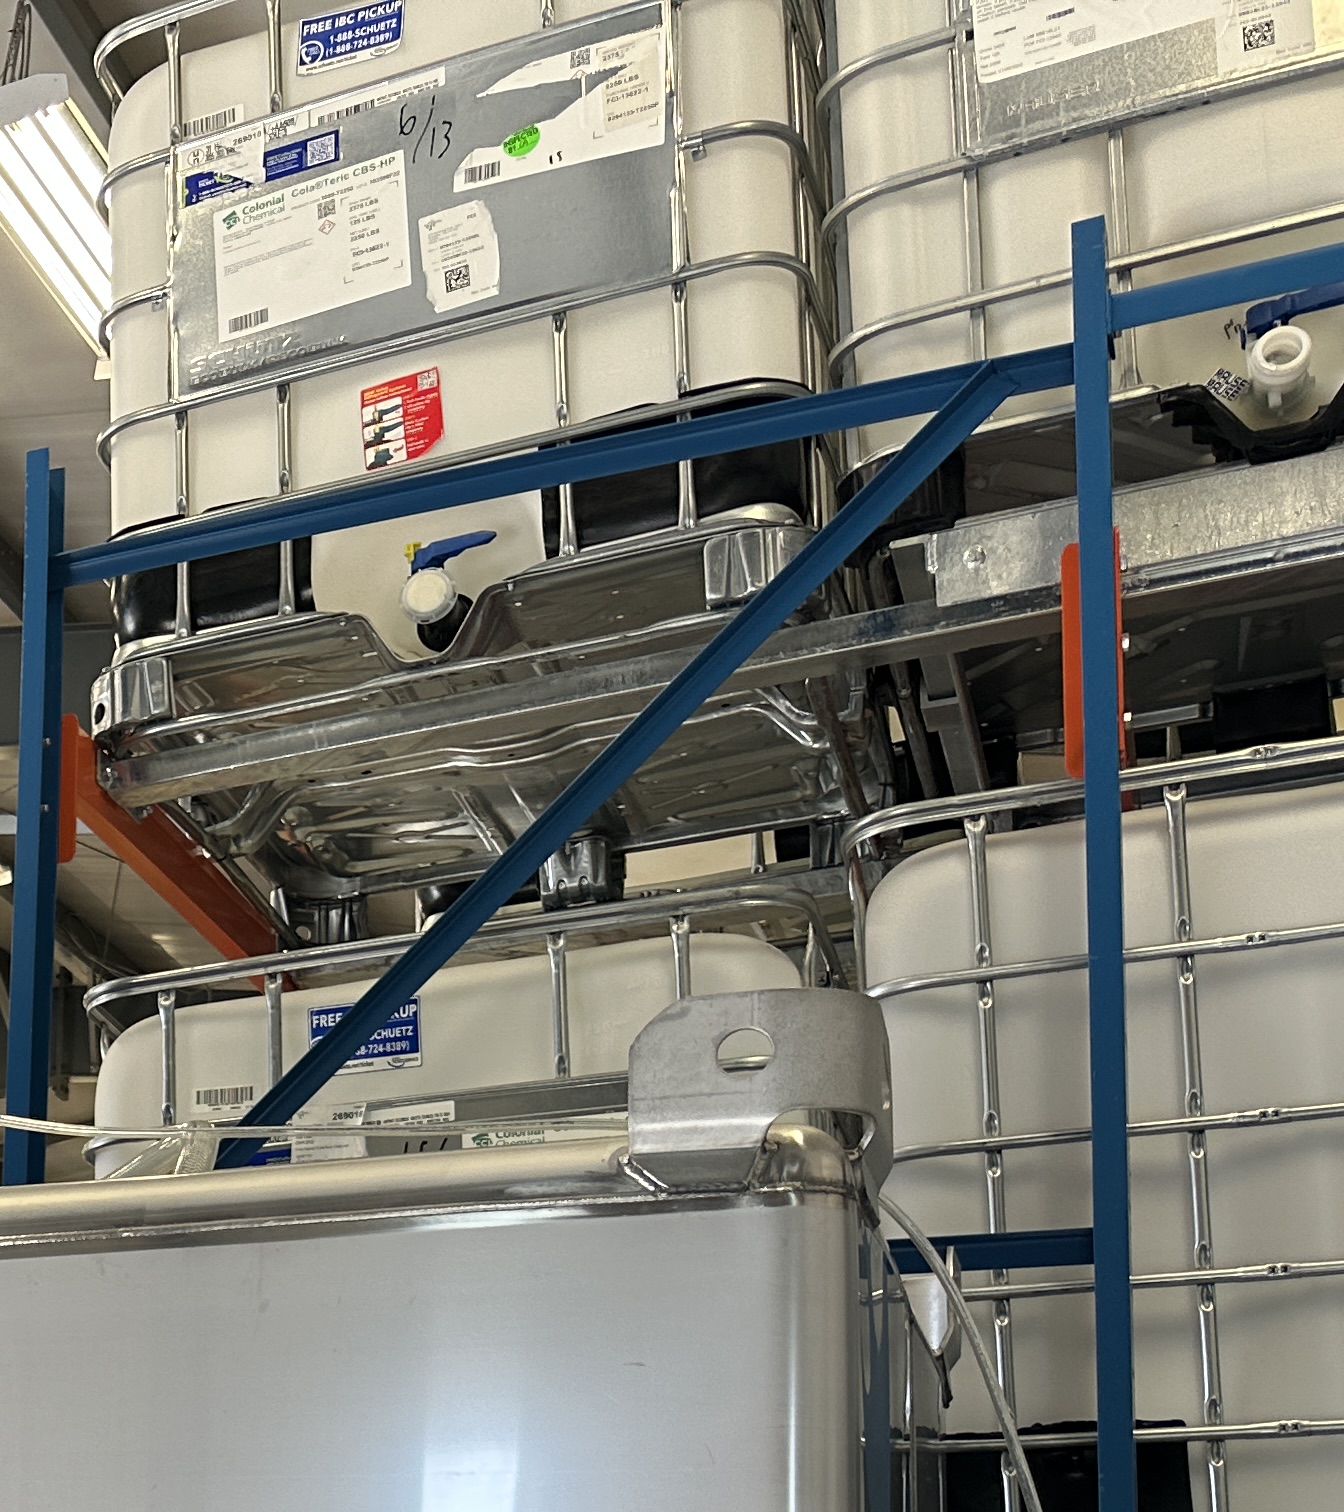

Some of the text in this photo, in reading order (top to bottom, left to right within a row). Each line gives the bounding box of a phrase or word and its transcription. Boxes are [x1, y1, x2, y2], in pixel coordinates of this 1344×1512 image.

[303, 1, 402, 36] FREE IBC PICKUP
[352, 156, 396, 177] CBS-HP
[242, 193, 284, 215] Colonial
[243, 203, 285, 224] Chemical
